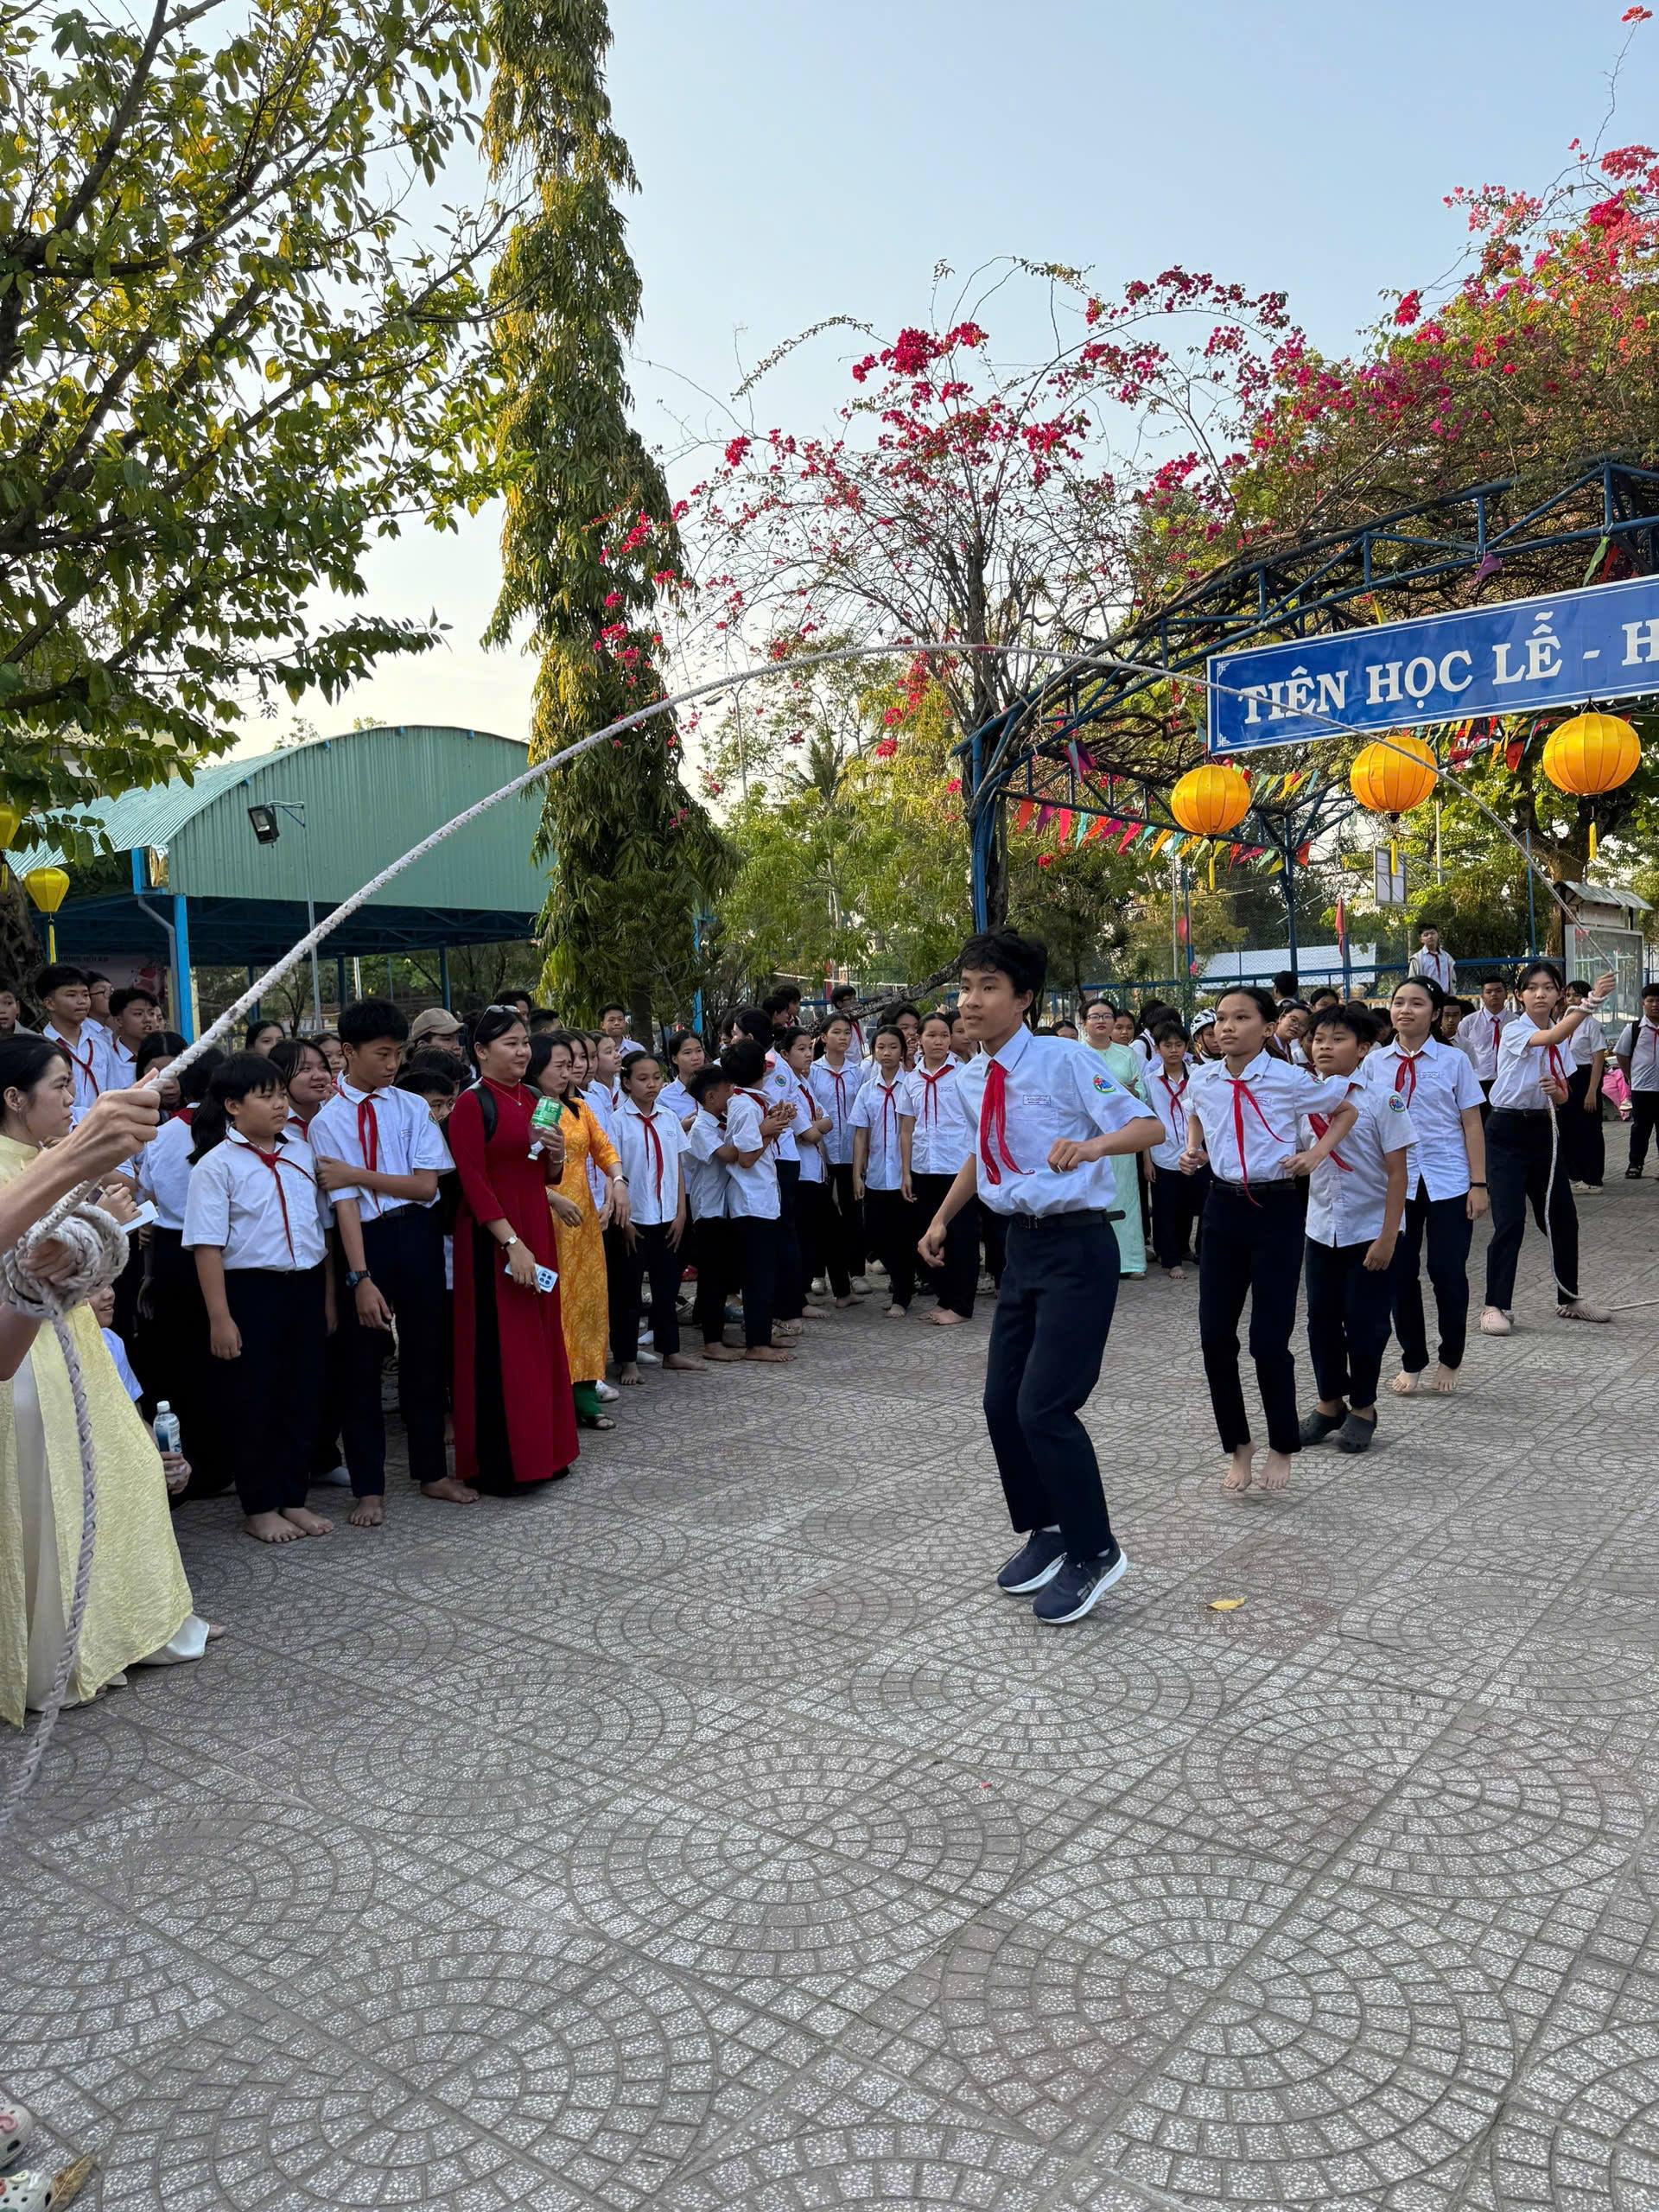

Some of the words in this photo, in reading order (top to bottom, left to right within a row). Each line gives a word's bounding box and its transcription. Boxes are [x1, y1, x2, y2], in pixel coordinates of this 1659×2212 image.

[1237, 664, 1350, 725] TIÊN
[1365, 649, 1473, 709] HỌC
[1491, 610, 1563, 685] LỄ
[1582, 649, 1601, 660] -
